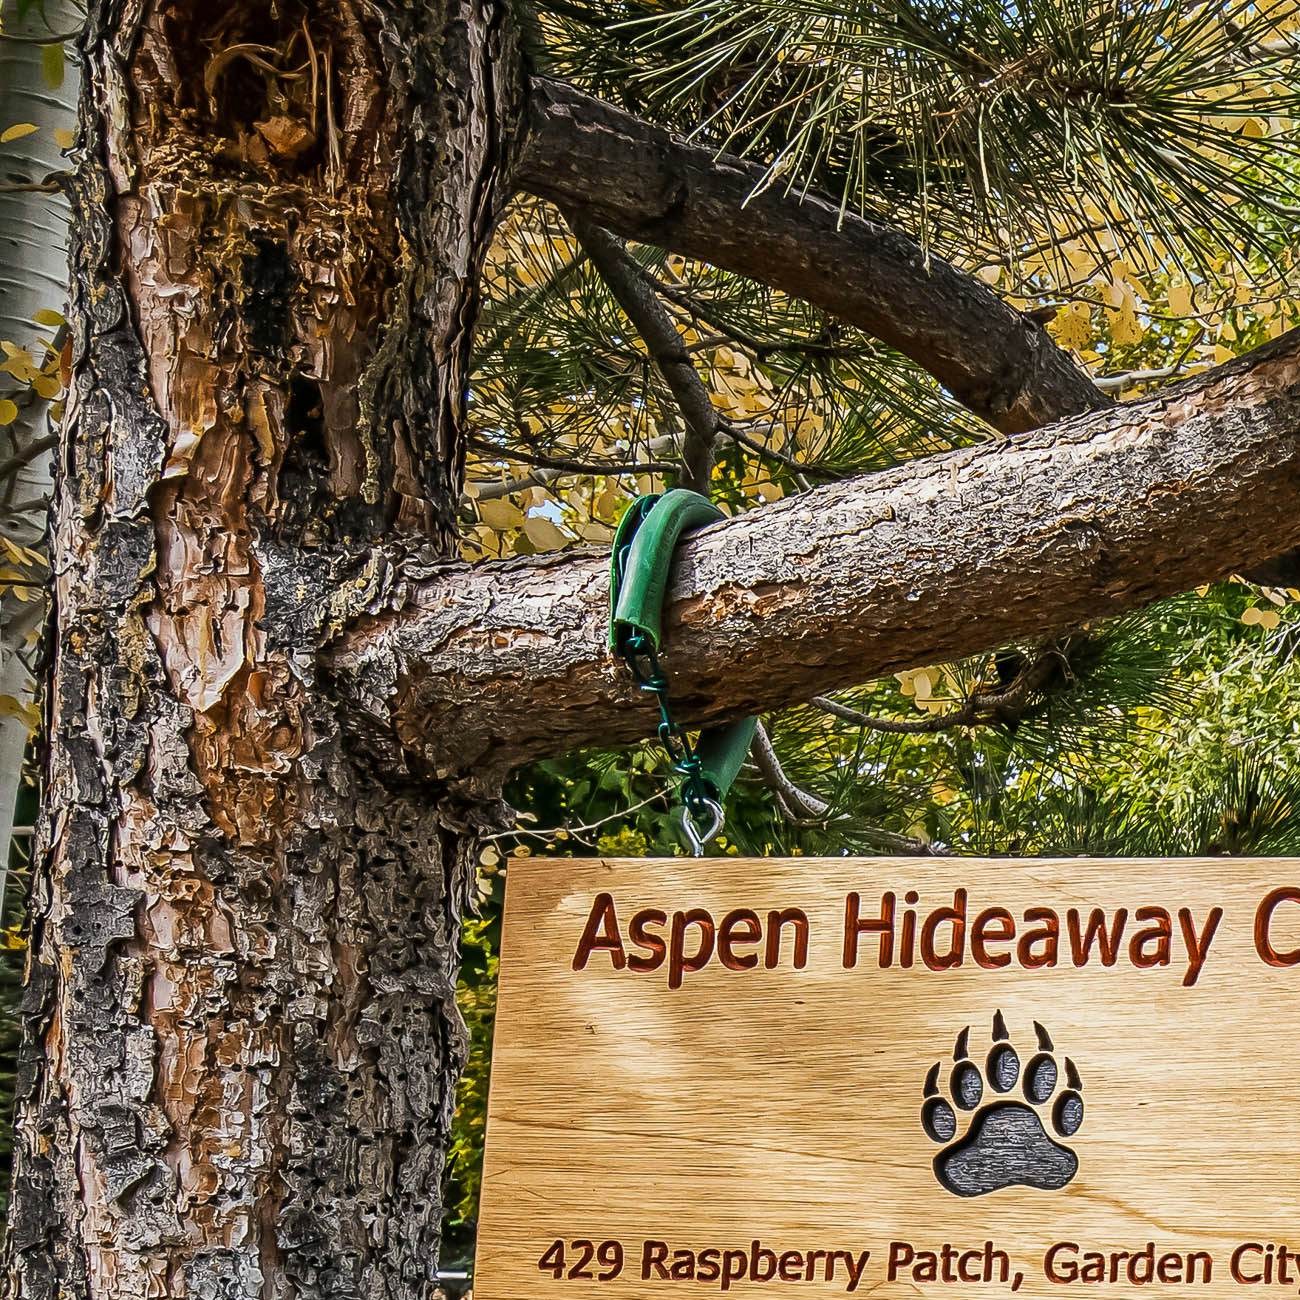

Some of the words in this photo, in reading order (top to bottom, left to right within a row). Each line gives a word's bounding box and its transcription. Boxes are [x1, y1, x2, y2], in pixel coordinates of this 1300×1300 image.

[573, 892, 808, 989] Aspen
[843, 887, 1223, 987] Hideaway
[537, 1239, 624, 1282] 429
[641, 1239, 870, 1291] Raspberry
[887, 1241, 1024, 1292] Patch,
[1043, 1242, 1213, 1285] Garden
